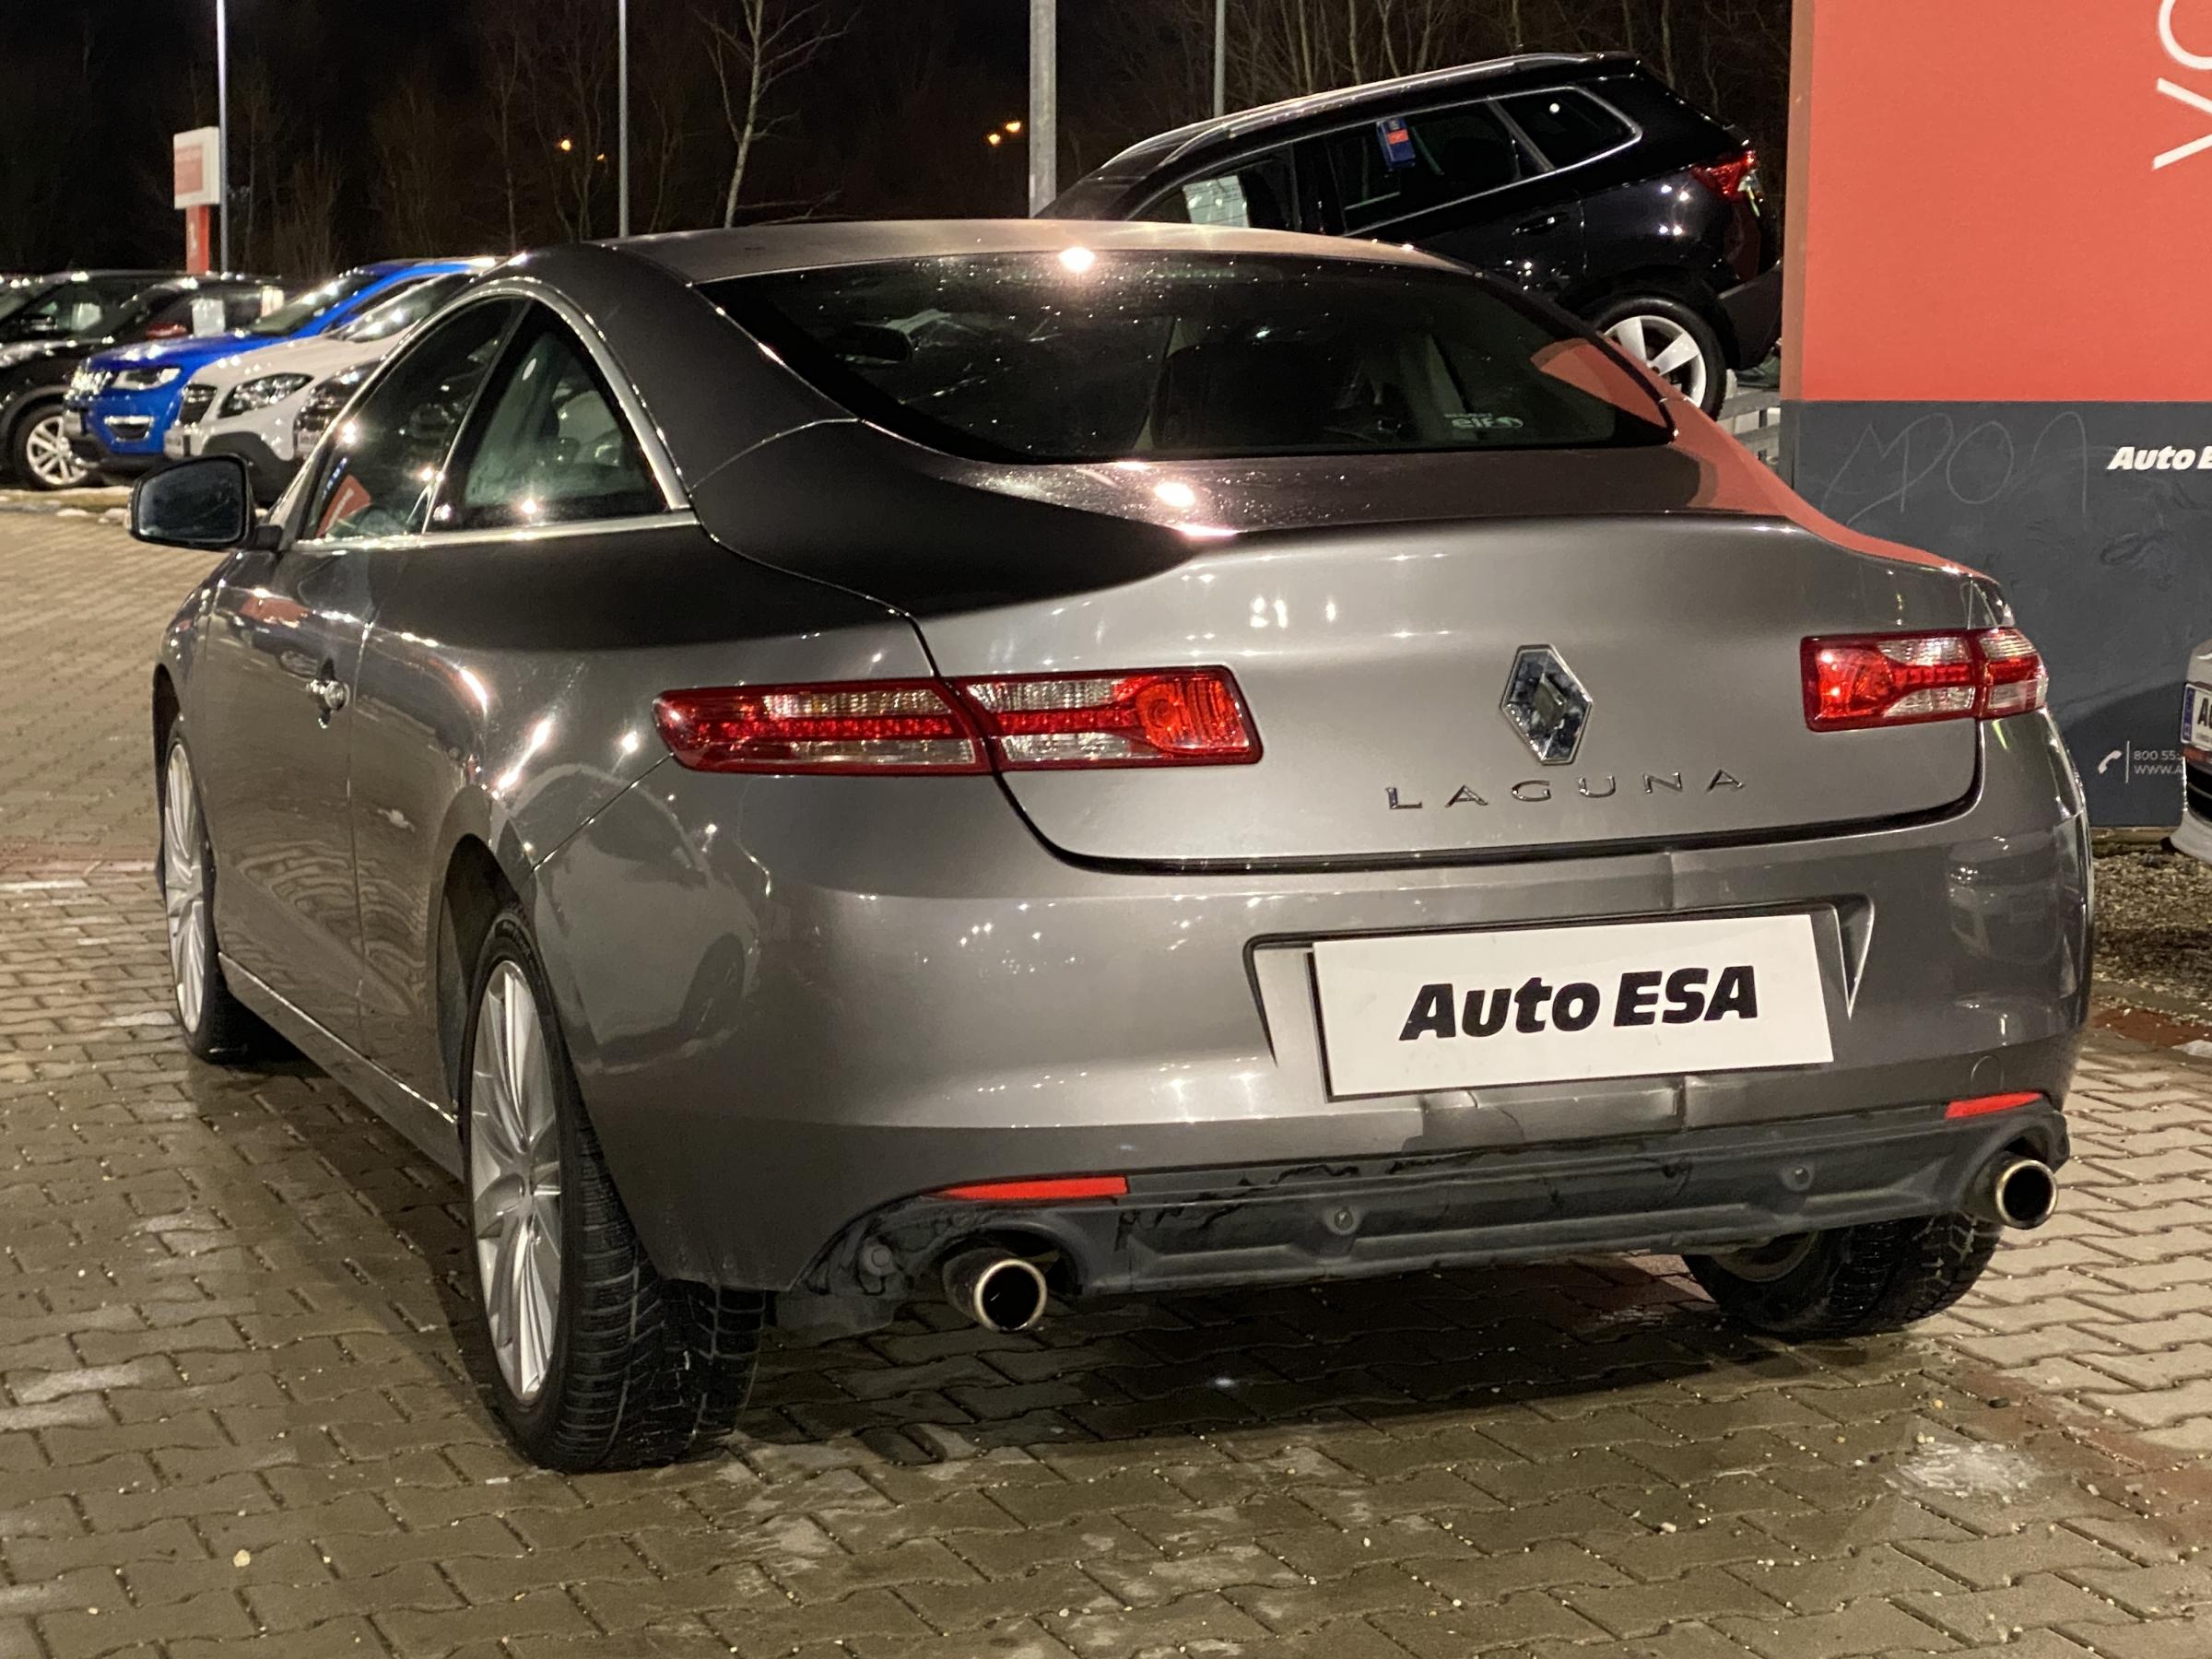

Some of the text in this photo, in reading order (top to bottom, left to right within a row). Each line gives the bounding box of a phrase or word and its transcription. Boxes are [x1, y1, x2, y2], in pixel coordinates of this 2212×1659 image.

[2107, 446, 2196, 470] Auto
[2134, 750, 2158, 760] 800
[1386, 769, 1746, 809] LAGUNA
[1399, 965, 1758, 1041] Auto ESA
